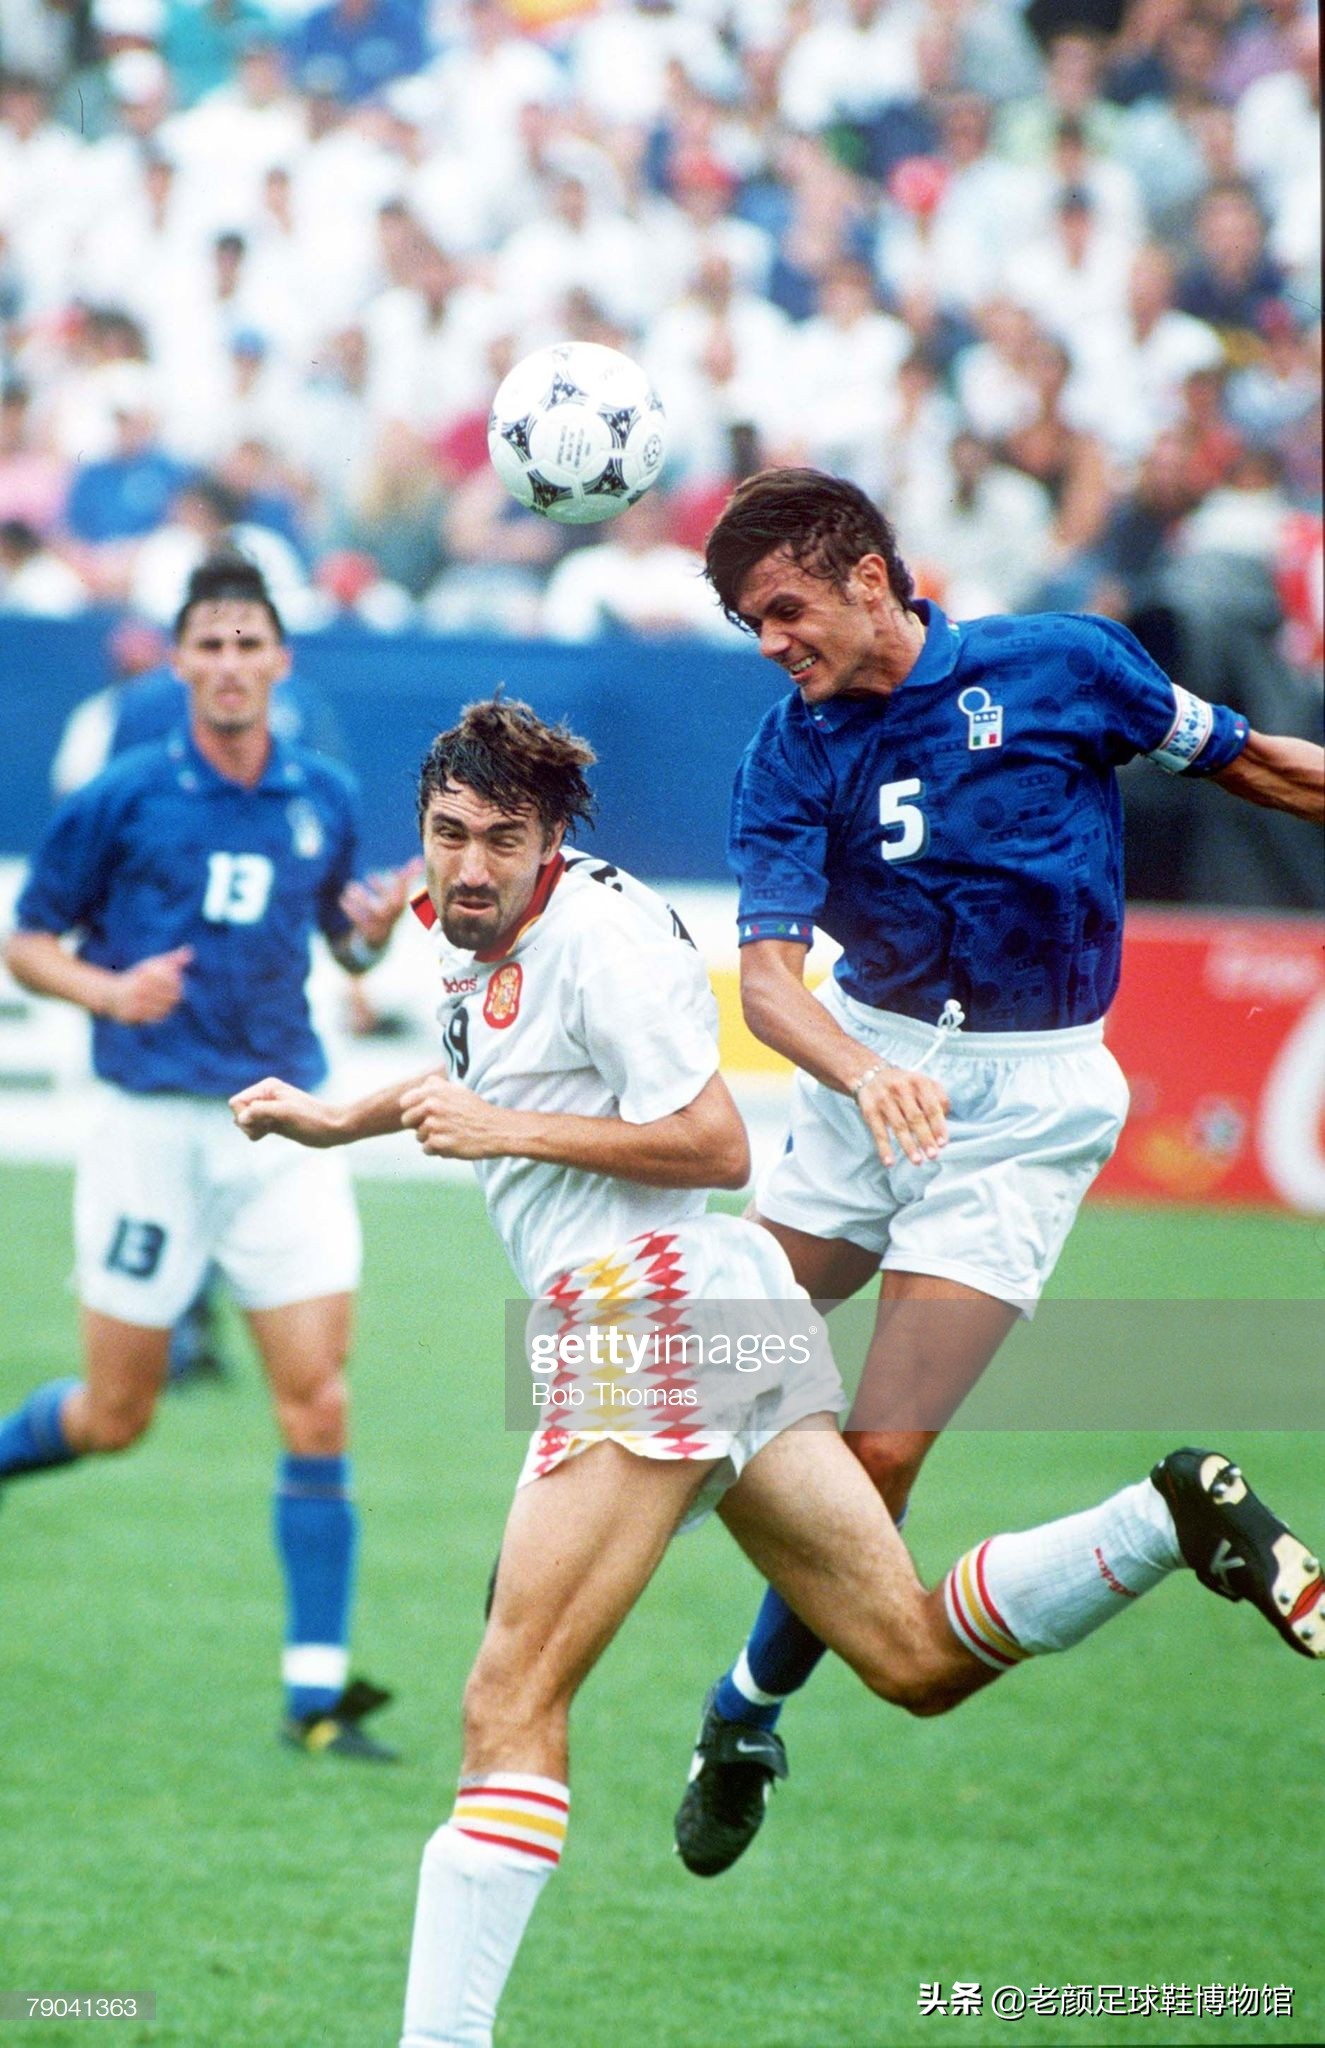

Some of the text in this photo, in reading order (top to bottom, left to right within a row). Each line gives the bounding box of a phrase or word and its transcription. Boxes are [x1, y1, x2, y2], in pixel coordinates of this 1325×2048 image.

[879, 777, 930, 865] 5
[203, 851, 274, 926] 13
[106, 1216, 167, 1280] 13
